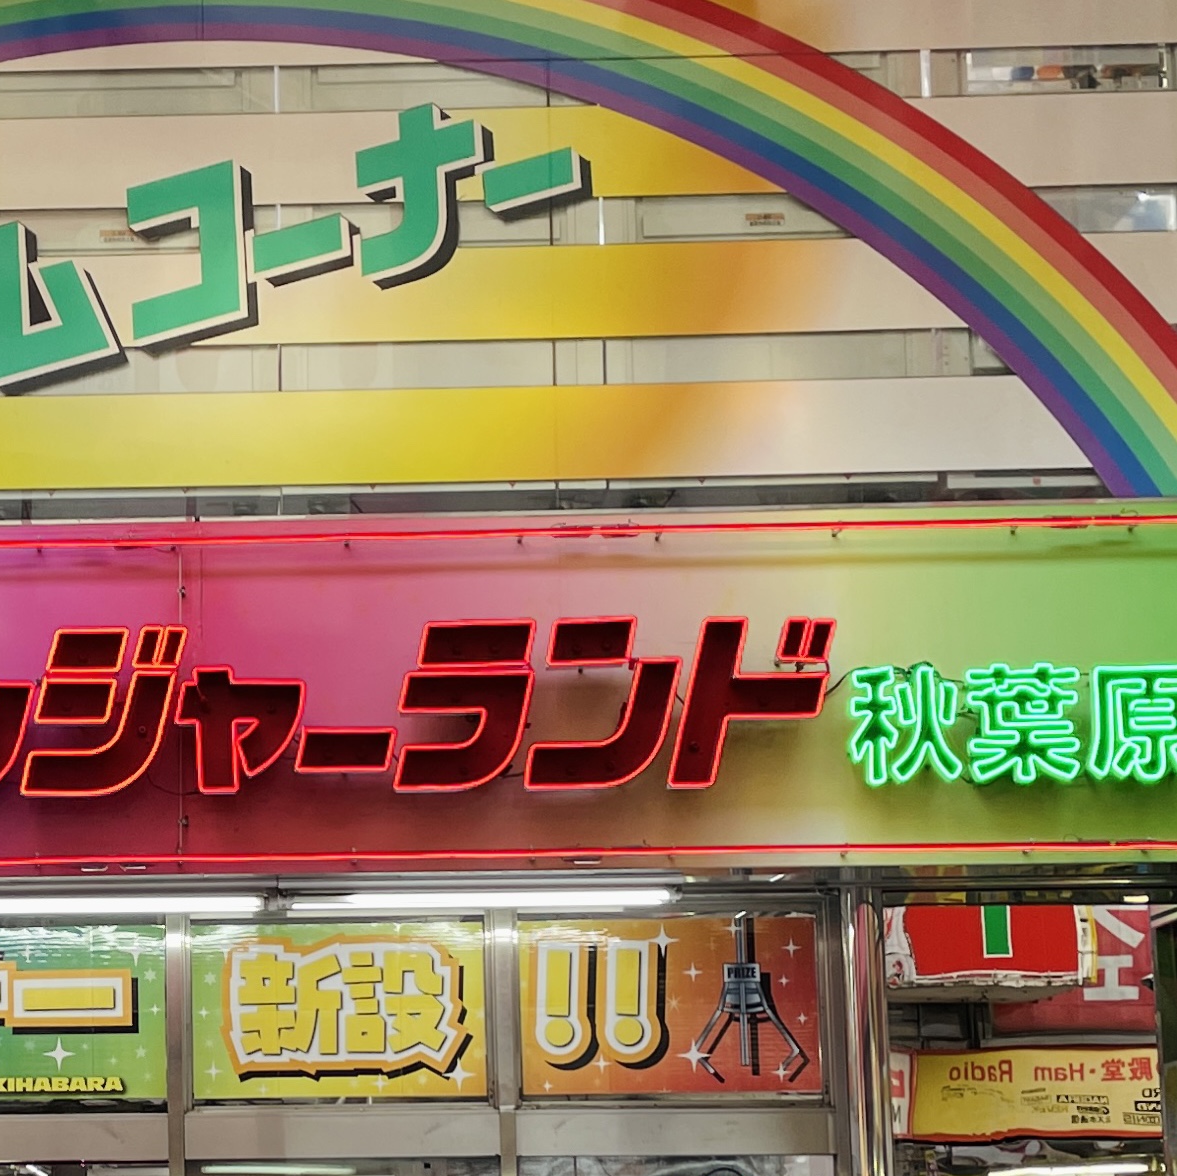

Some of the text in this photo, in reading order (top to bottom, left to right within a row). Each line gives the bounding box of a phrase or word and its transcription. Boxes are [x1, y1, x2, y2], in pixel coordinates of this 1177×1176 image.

[847, 662, 1177, 787] 秋葉原
[726, 964, 759, 980] PRIZE
